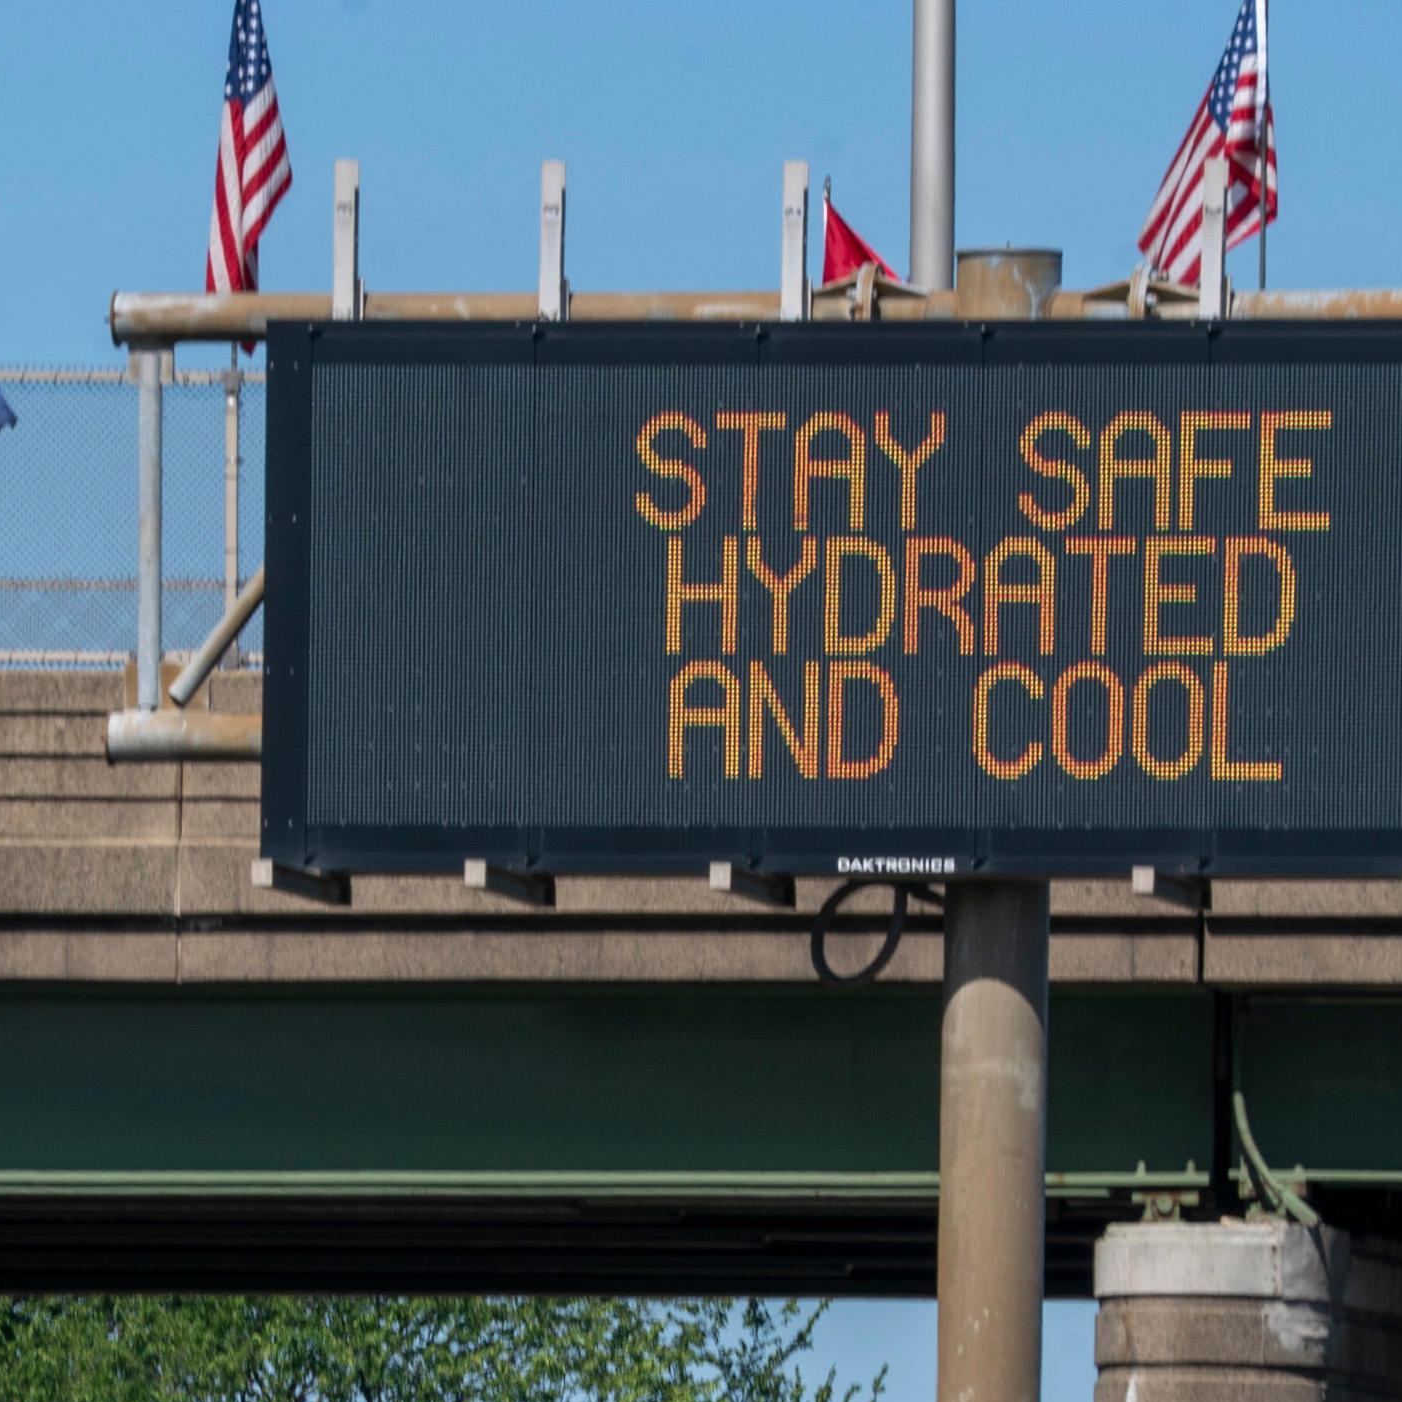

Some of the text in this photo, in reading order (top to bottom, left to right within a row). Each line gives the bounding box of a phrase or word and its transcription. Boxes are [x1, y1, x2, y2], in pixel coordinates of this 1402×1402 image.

[635, 410, 1332, 531] STAY SAFE
[665, 535, 1296, 656] HYDRATED
[668, 660, 1283, 780] AND COOL
[837, 856, 956, 874] DAKTRONICS
